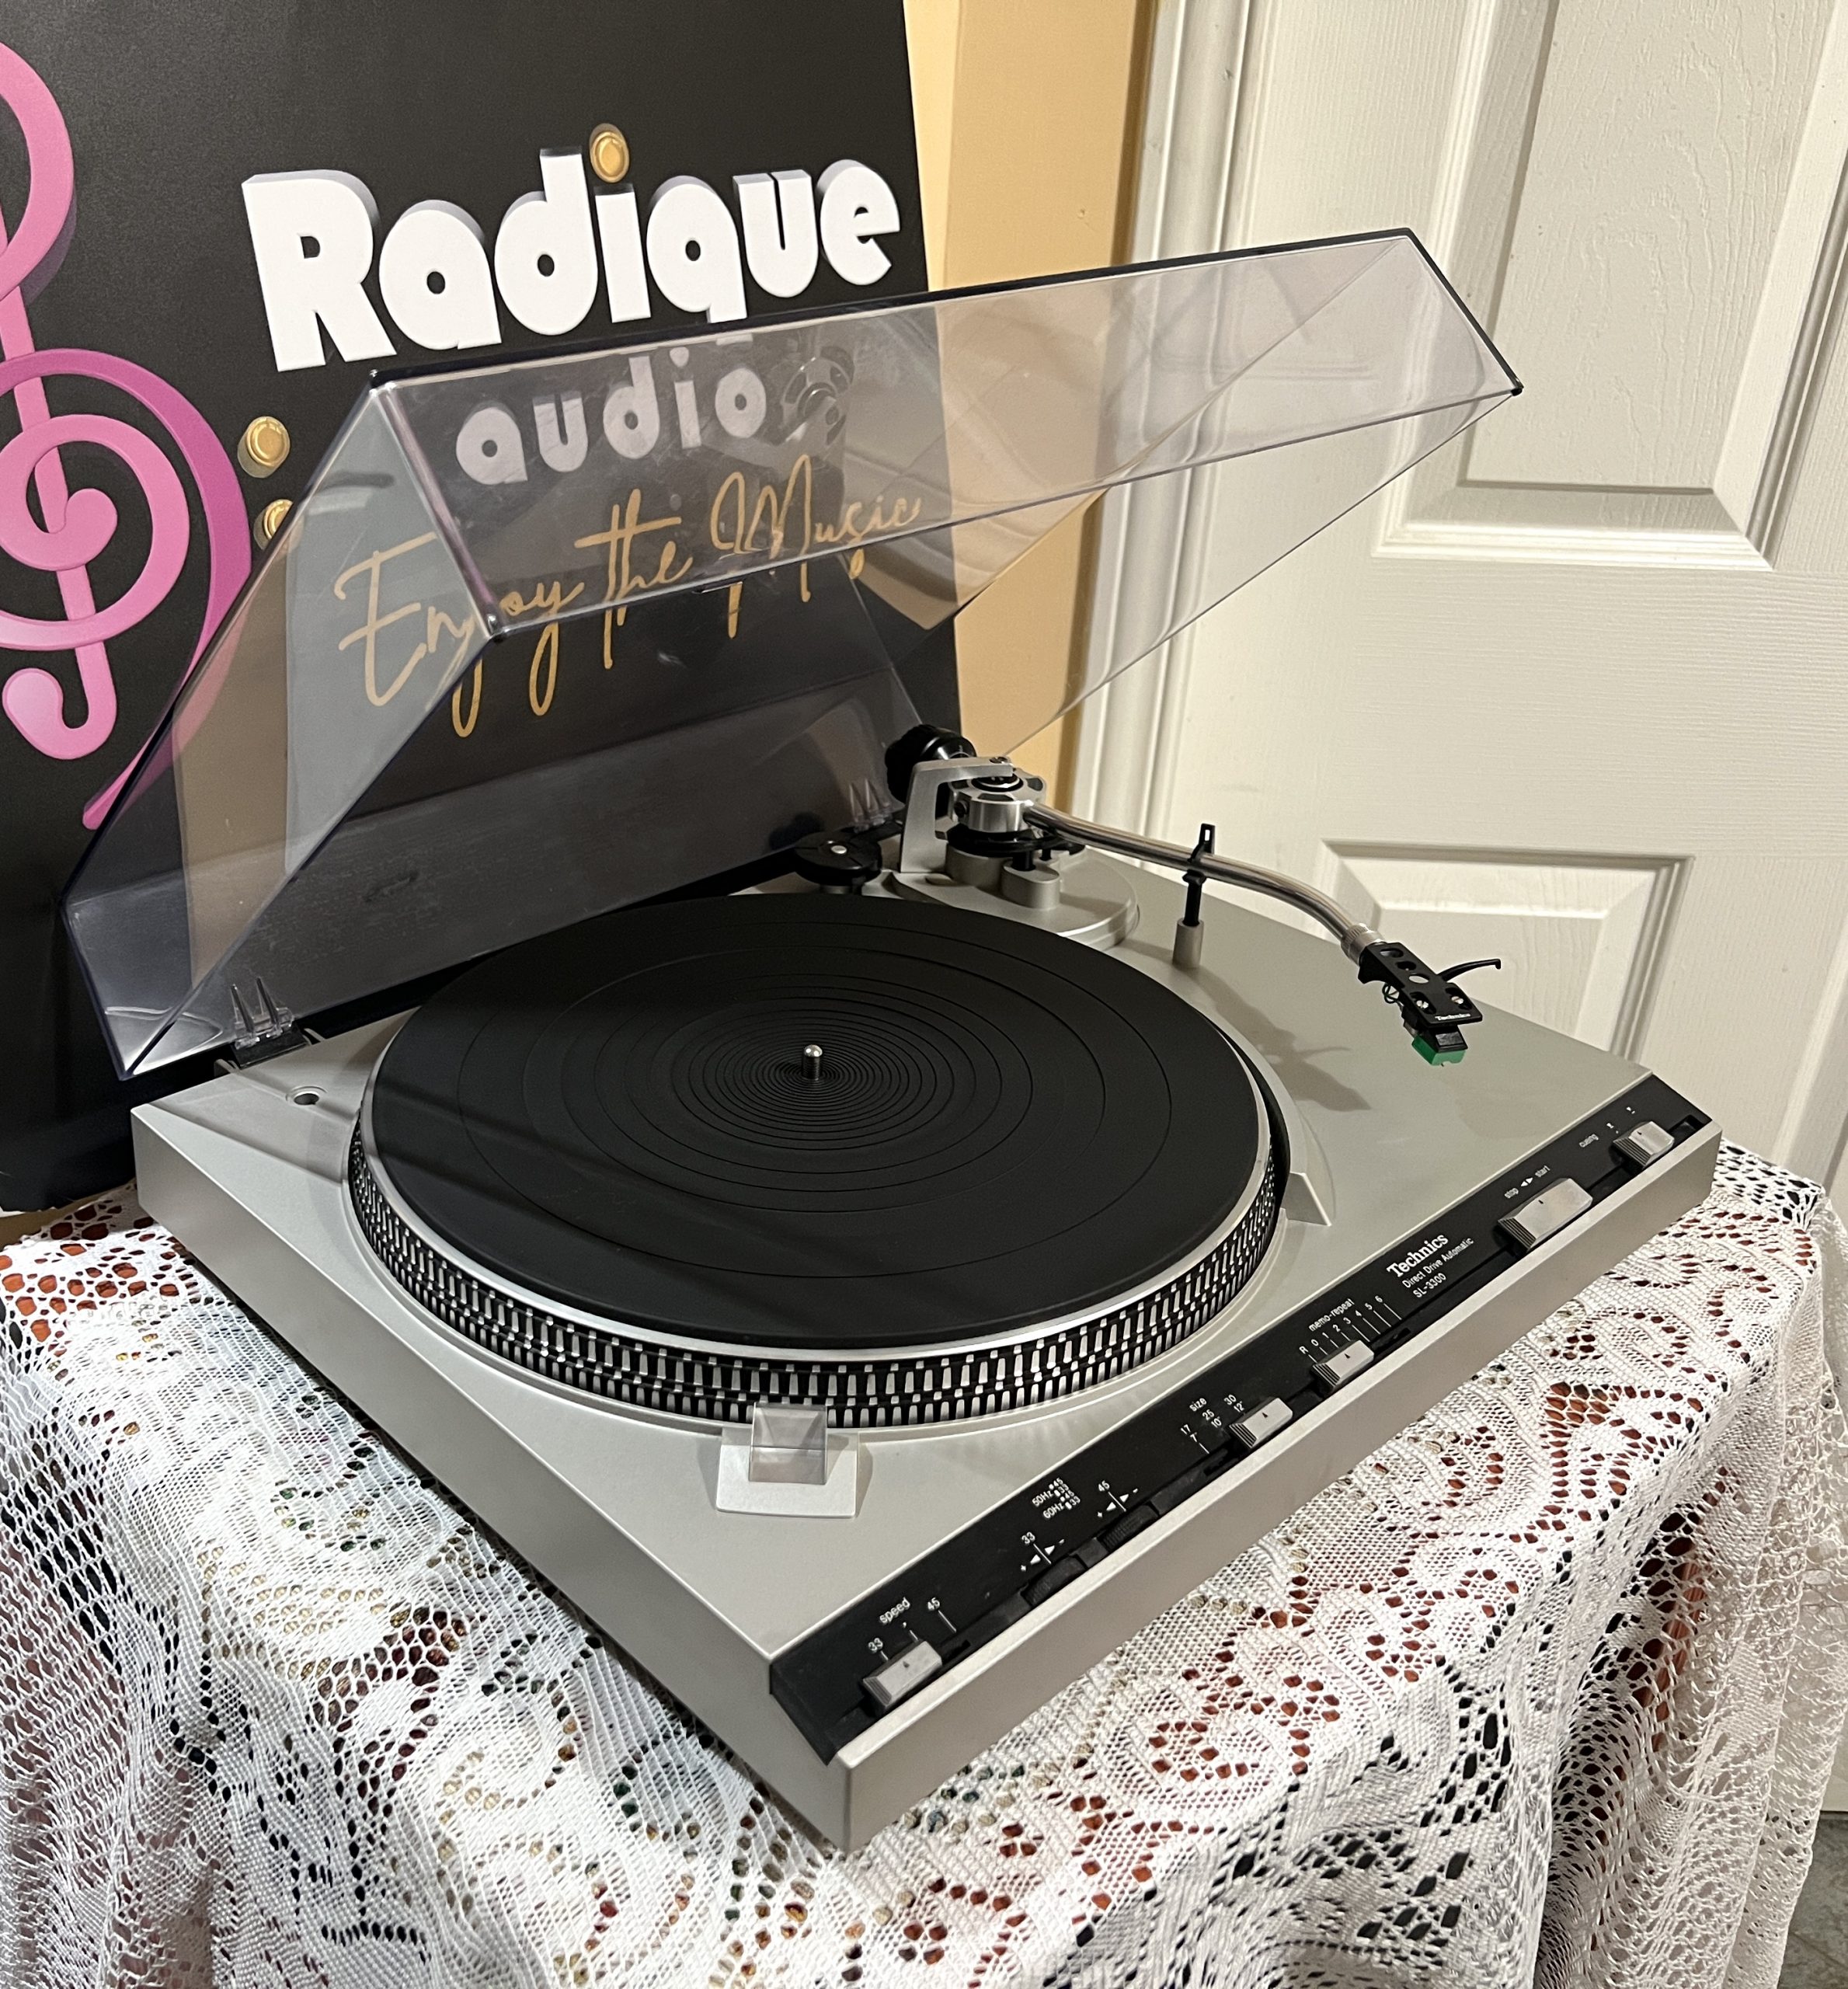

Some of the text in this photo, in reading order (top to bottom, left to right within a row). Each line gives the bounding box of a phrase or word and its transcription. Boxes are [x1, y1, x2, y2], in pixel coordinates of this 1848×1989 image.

[242, 125, 900, 371] Radique
[456, 348, 767, 485] audio
[333, 455, 922, 737] Enjoy the Music
[1534, 1165, 1550, 1177] start
[1386, 1234, 1449, 1277] Technics
[1401, 1238, 1474, 1288] Direct Drive Automatic
[1412, 1273, 1446, 1298] SL-3300
[1308, 1298, 1355, 1332] memo-repeat
[1299, 1346, 1309, 1354] R
[1332, 1324, 1341, 1332] 2
[1181, 1394, 1237, 1435] 17 25 30
[1189, 1398, 1207, 1412] size
[1032, 1490, 1053, 1507] 50Hz
[1098, 1480, 1110, 1492] 45
[1043, 1503, 1064, 1519] 60Hz
[1069, 1496, 1081, 1506] 33
[1021, 1531, 1035, 1545] 33
[868, 1597, 941, 1653] 33 45
[879, 1597, 910, 1625] speed
